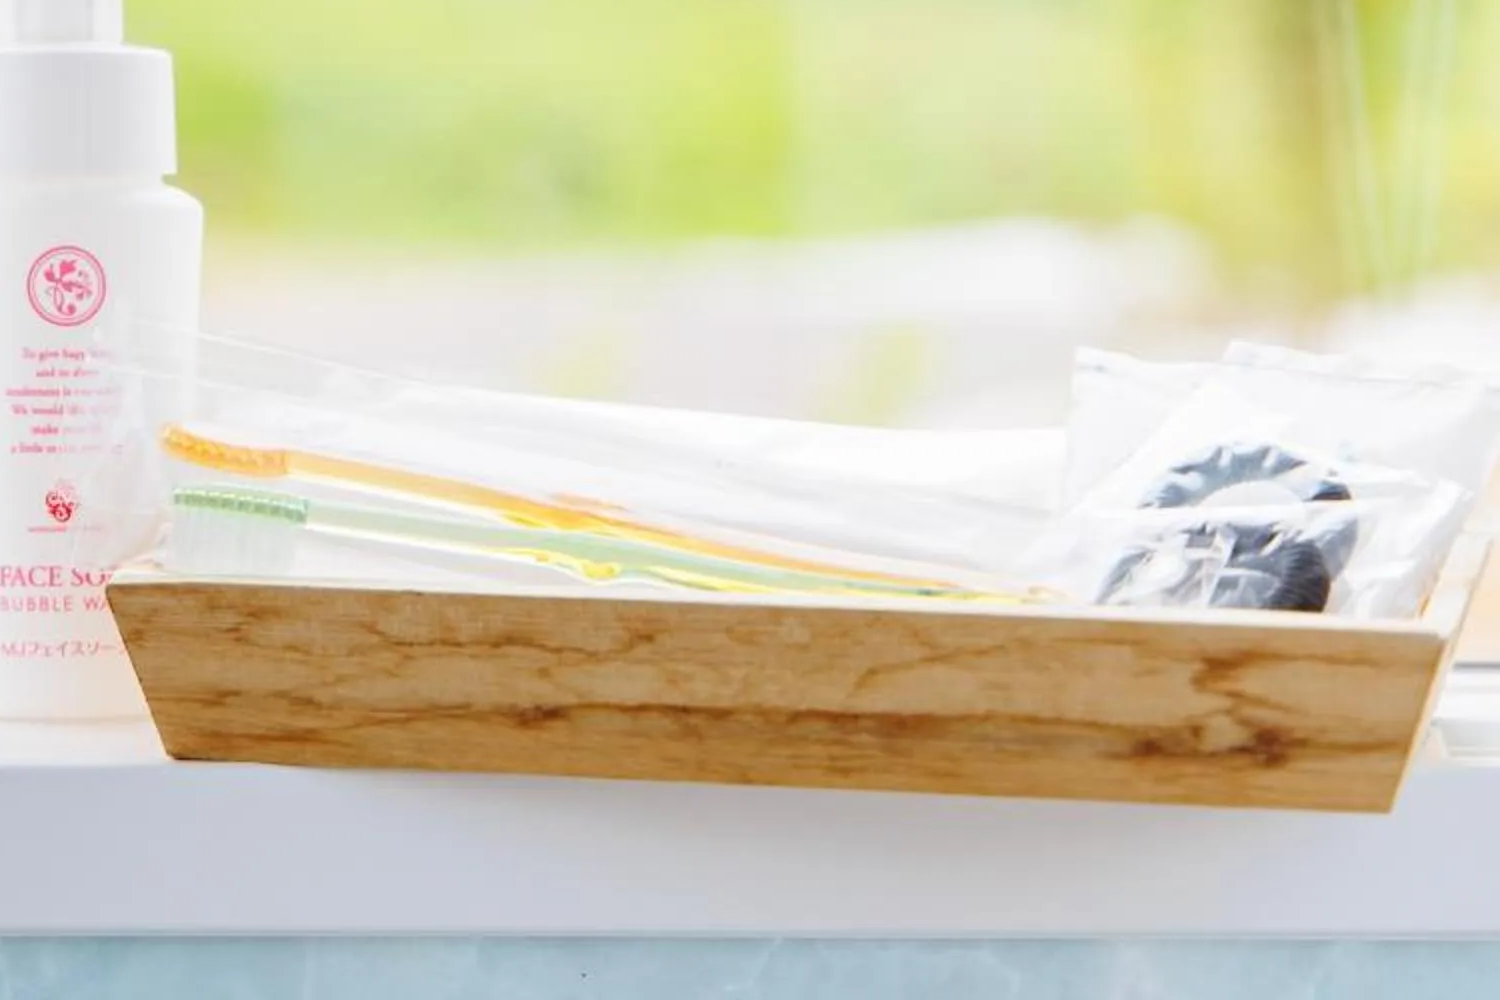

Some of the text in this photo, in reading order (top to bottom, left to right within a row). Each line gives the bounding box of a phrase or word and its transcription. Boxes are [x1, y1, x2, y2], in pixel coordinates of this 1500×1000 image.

[0, 565, 63, 589] FACE
[0, 595, 75, 613] BUBBLE
[1, 638, 122, 659] MJフェイスソー
